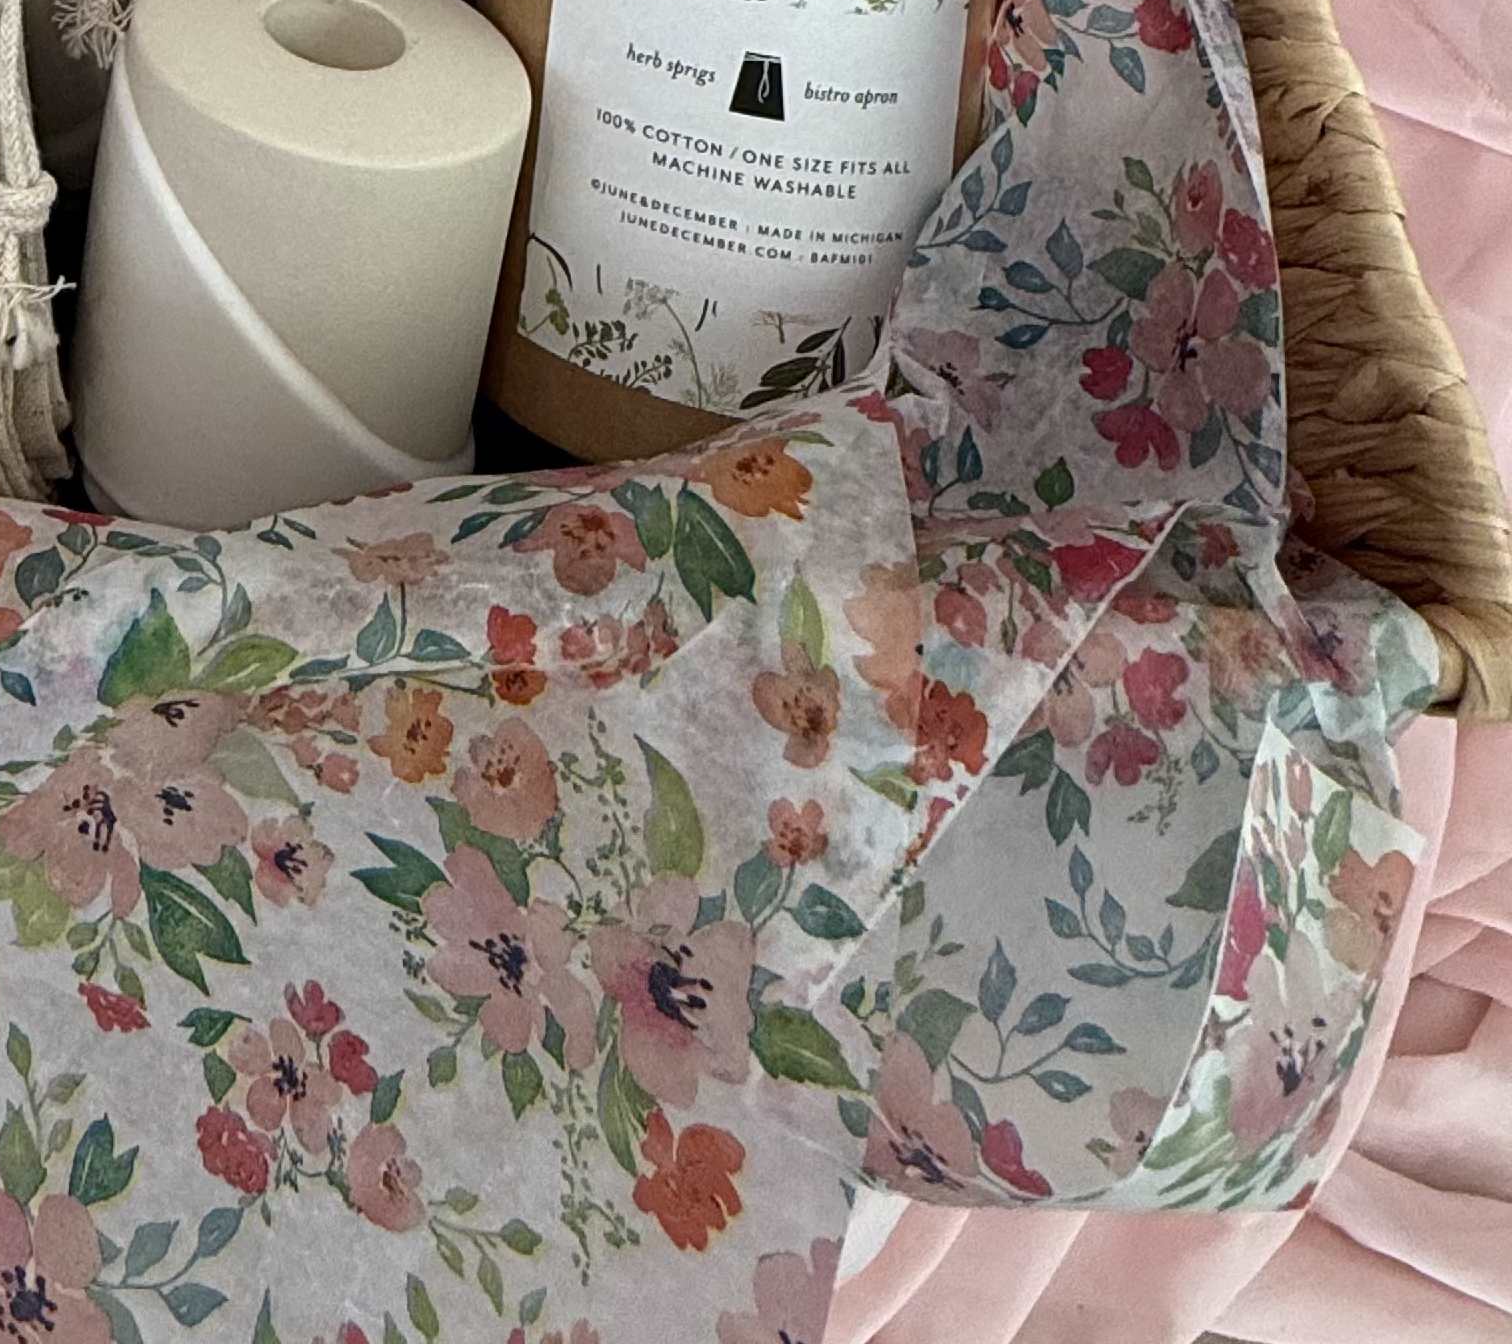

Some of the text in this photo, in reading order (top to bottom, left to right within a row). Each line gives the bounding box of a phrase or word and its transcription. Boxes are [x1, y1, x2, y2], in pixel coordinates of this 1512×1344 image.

[626, 42, 716, 87] herb sprigs
[804, 81, 899, 110] bistro apron
[596, 108, 637, 134] 100%
[642, 124, 723, 157] COTTON
[742, 149, 785, 170] ONE
[792, 157, 833, 174] SIZE
[839, 160, 878, 176] FITS
[883, 161, 911, 175] ALL
[652, 151, 858, 200] MACHINE WASHABLE
[757, 224, 804, 241] MADE
[810, 230, 826, 243] IN
[832, 231, 904, 244] MICHIGAN
